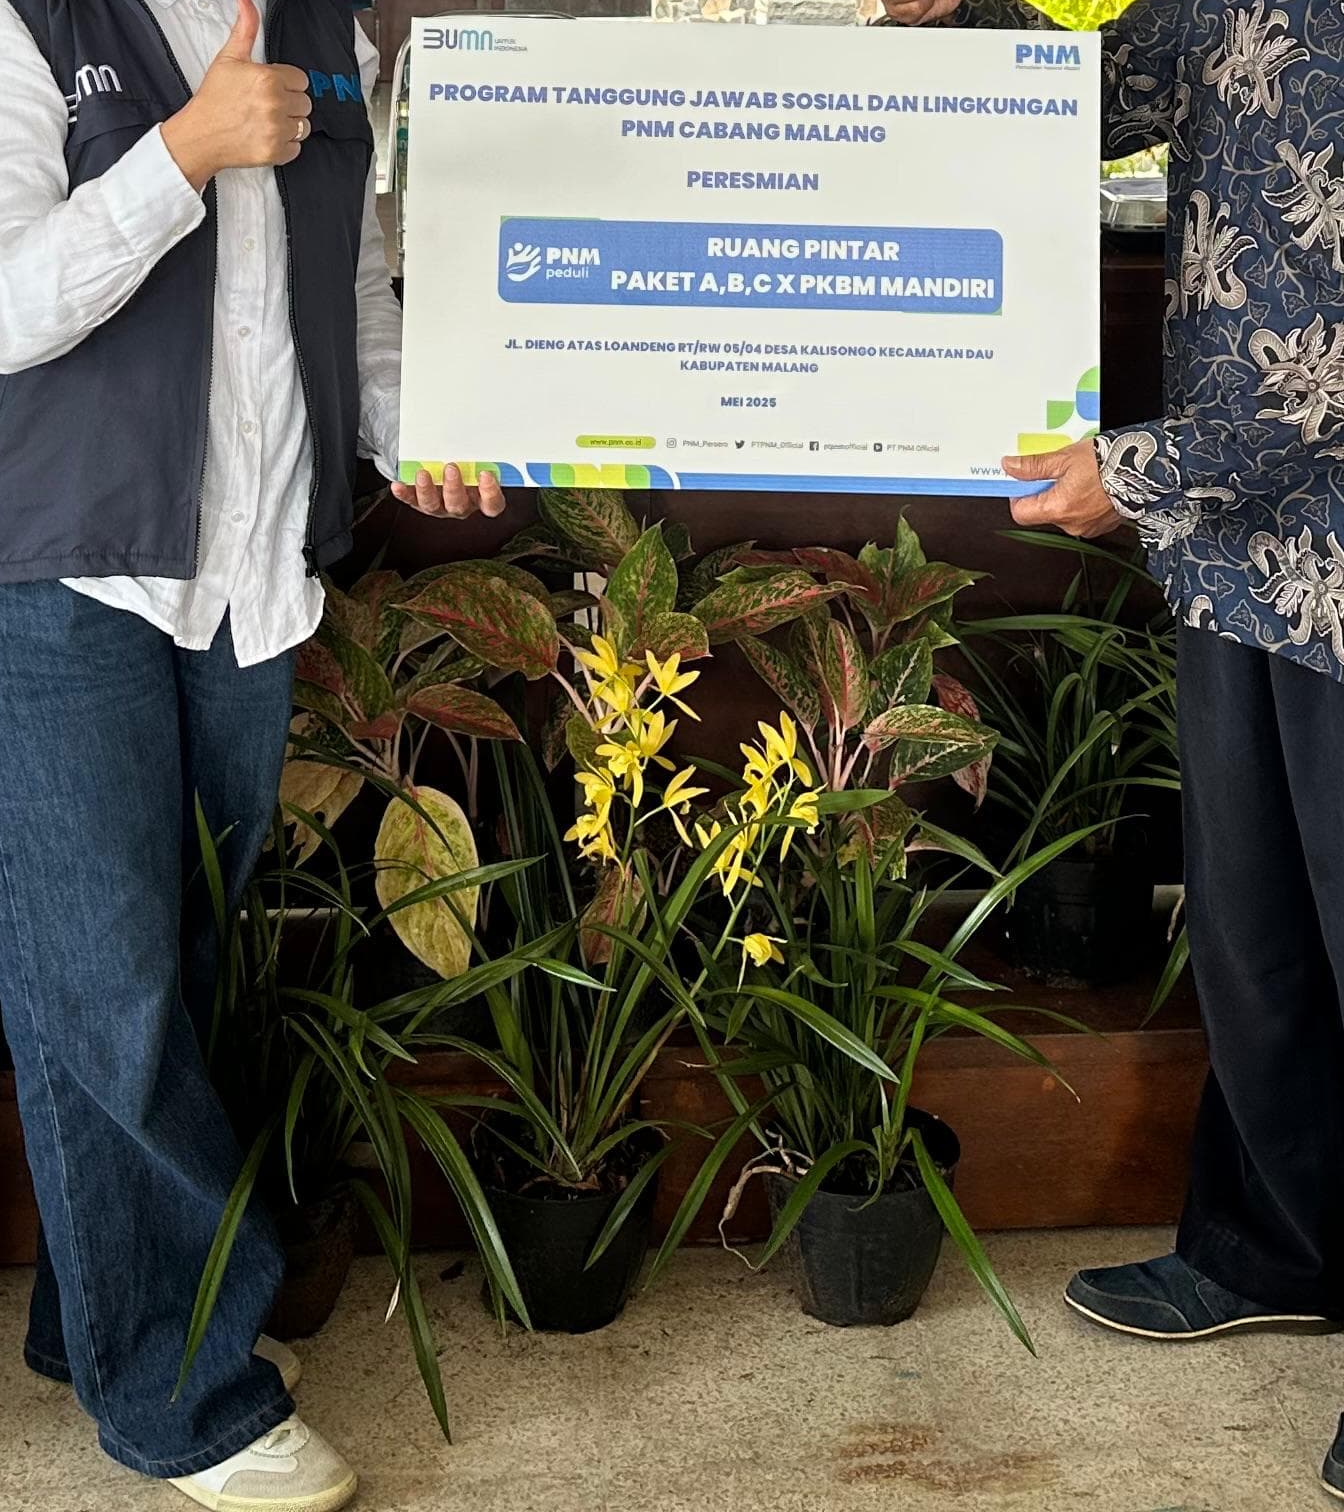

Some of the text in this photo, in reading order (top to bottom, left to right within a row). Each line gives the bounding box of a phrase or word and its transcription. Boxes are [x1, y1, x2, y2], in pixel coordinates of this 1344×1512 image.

[1016, 44, 1080, 65] PNM
[429, 83, 1078, 116] PROGRAM TANGGUNG JAWAB SOSIAL DAN LINGKUNGAN
[622, 120, 886, 143] PNM CABANG MALANG
[687, 171, 819, 191] PERESMIAN
[546, 247, 601, 266] PNM
[707, 237, 900, 261] RUANG PINTAR
[546, 267, 589, 280] peduli
[611, 270, 994, 299] PAKET A,B,C X PKBM MANDIRI
[504, 339, 994, 360] JL. DIENG ATAS LOANDENG RT/RW 05/04 DESA KALISONGO KECAMATAN DAU
[680, 360, 819, 373] KABUPATEN MALANG
[720, 396, 776, 408] MEI 2025
